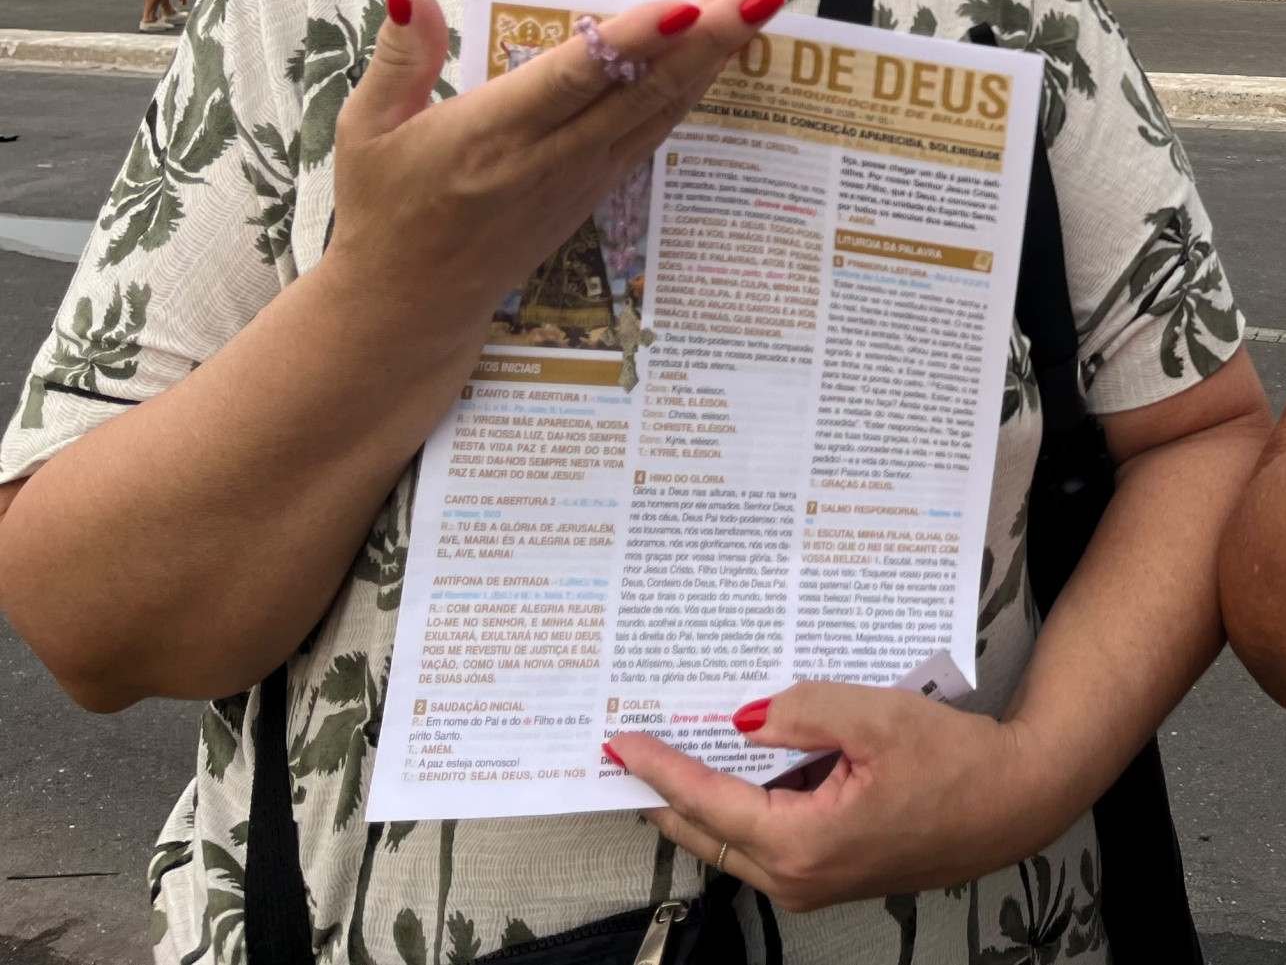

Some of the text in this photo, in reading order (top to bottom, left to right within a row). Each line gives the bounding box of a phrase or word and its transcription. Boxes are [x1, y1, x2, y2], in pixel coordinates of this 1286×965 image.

[790, 40, 856, 94] DE
[872, 54, 1010, 121] DEUS
[904, 108, 926, 121] DE
[838, 235, 943, 260] LITURGIA DA PALAVRA
[502, 362, 542, 374] INICIAIS
[476, 388, 510, 398] CANTO
[512, 390, 525, 399] DE
[529, 390, 580, 401] ABERTURA
[582, 392, 587, 401] 1
[474, 415, 628, 430] VIRGEM MÃE APARECIDA, NOSSA
[456, 428, 477, 437] VIDA
[479, 429, 486, 438] E
[487, 429, 522, 439] NOSSA
[547, 431, 586, 441] DAI-NOS
[589, 432, 626, 442] SEMPRE
[453, 442, 626, 455] NESTA VIDA PAZ E AMOR DO BOM
[486, 456, 526, 466] DAI-NOS
[528, 457, 568, 467] SEMPRE
[570, 458, 600, 468] NESTA
[603, 459, 624, 468] VIDA
[448, 469, 467, 478] PAZ
[469, 469, 476, 478] E
[478, 469, 508, 478] AMOR
[509, 470, 524, 479] DO
[526, 470, 549, 479] BOM
[445, 496, 478, 505] CANTO
[480, 496, 494, 505] DE
[496, 496, 548, 506] ABERTURA
[550, 497, 555, 506] 2
[458, 522, 470, 531] TU
[490, 523, 498, 531] A
[499, 521, 537, 532] GLÓRIA
[540, 523, 553, 532] DE
[463, 536, 499, 545] MARIA!
[518, 537, 526, 545] A
[528, 537, 570, 546] ALEGRIA
[572, 537, 586, 546] DE
[589, 538, 614, 546] ISRA-
[438, 550, 452, 560] EL,
[478, 550, 513, 558] MARIA!
[434, 575, 483, 586] ANTÍFONA
[486, 577, 499, 586] DE
[503, 577, 549, 586] ENTRADA
[447, 604, 605, 613] COM GRANDE ALEGRIA REJUBI-
[428, 618, 459, 627] LO-ME
[462, 618, 479, 627] NO
[530, 618, 538, 627] E
[541, 618, 574, 627] MINHA
[577, 618, 605, 627] ALMA
[426, 630, 478, 642] EXULTARÁ,
[481, 630, 532, 641] EXULTARÁ
[533, 632, 548, 641] NO
[550, 632, 572, 641] MEU
[424, 646, 600, 656] POIS ME REVESTIU DE JUSTIÇA E SAL-
[462, 660, 494, 669] COMO
[498, 659, 521, 668] UMA
[523, 659, 554, 668] NOIVA
[557, 659, 600, 668] ORNADA
[420, 674, 432, 683] DE
[434, 674, 462, 683] SUAS
[431, 701, 488, 714] SAUDAÇÃO
[489, 702, 525, 711] INICIAL
[623, 701, 660, 710] COLETA
[426, 717, 442, 726] Em
[470, 716, 483, 725] do
[485, 716, 499, 725] Pai
[509, 716, 520, 725] do
[534, 716, 555, 725] Filho
[578, 715, 592, 724] Es-
[620, 714, 666, 724] OREMOS:
[410, 731, 462, 742] pírito Santo.
[678, 728, 689, 736] ao
[421, 744, 453, 754] AMÉM.
[701, 740, 742, 751] de Maria,
[419, 758, 426, 768] A
[427, 760, 444, 769] paz
[446, 758, 473, 769] esteja
[706, 754, 767, 762] concedei que
[419, 771, 466, 781] BENDITO
[470, 770, 498, 780] SEJA
[501, 770, 534, 781] DEUS,
[537, 769, 560, 779] QUE
